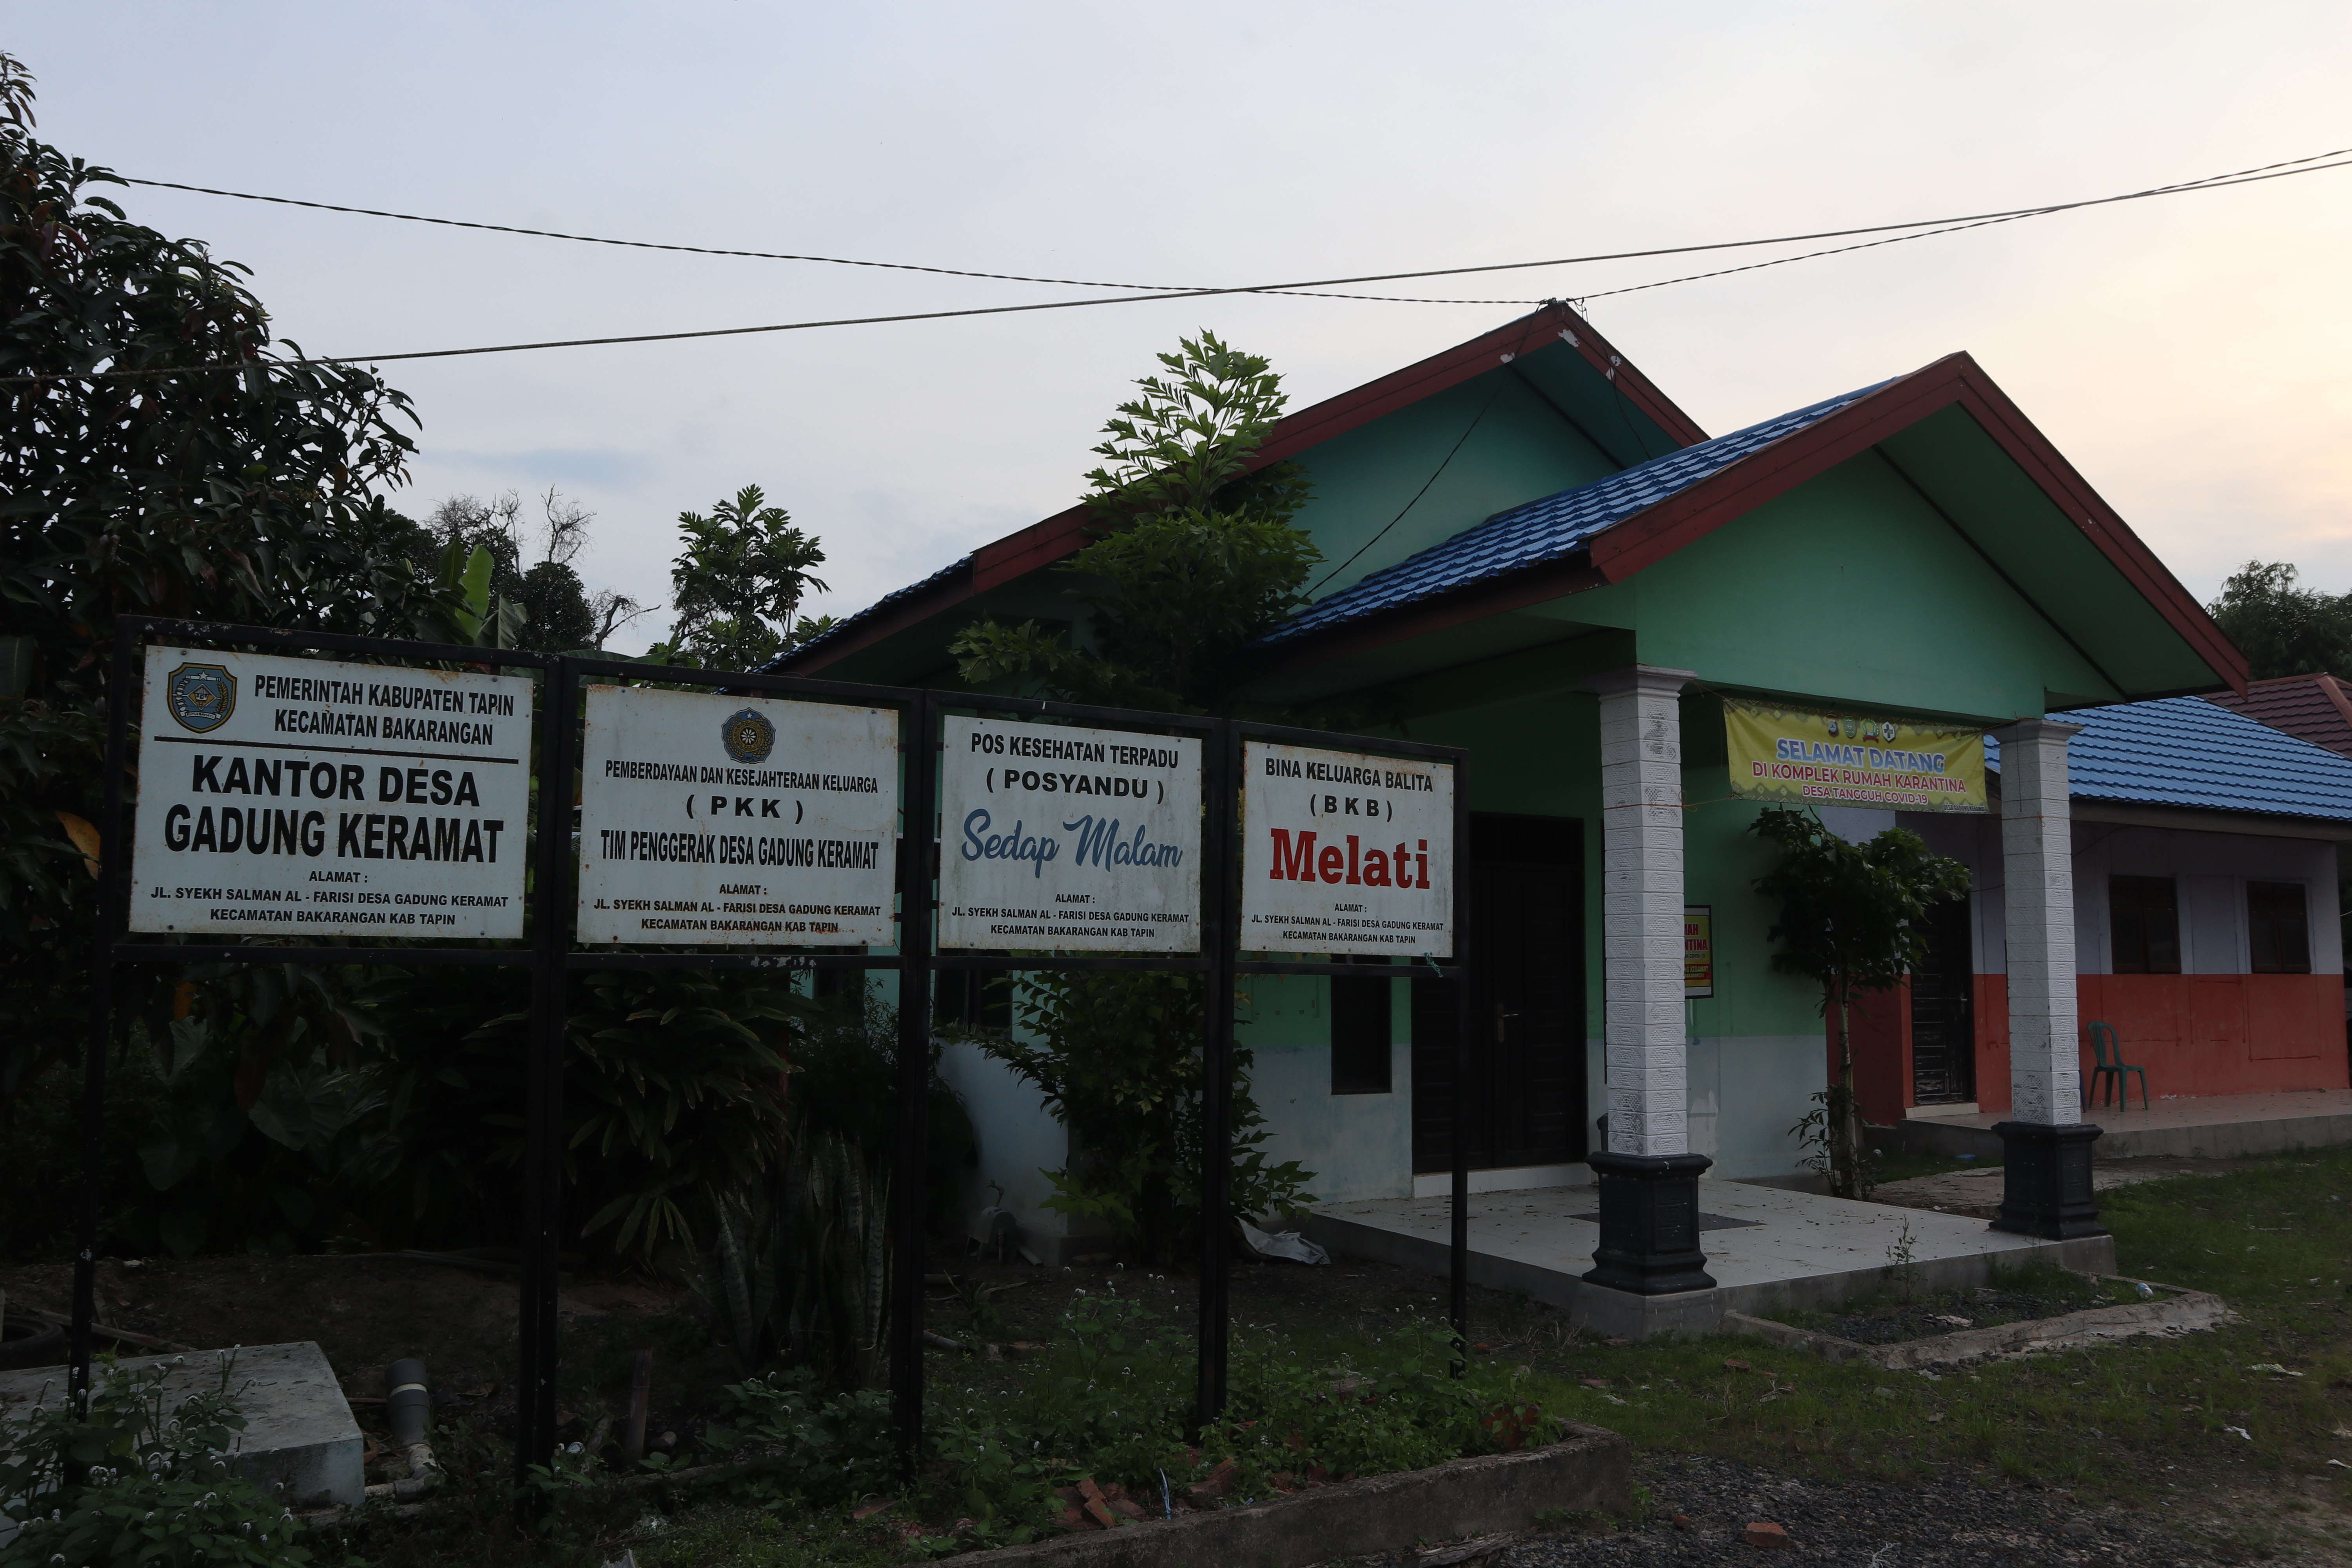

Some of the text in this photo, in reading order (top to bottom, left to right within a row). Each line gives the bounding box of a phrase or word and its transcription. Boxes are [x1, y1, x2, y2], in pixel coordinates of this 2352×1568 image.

[255, 675, 514, 716] PEMERINTAH KABUPATEN TAPIN
[274, 709, 493, 745] KECAMATAN BAKARANGAN
[971, 733, 1178, 769] POS KESEHATAN TERPADU
[1777, 738, 1945, 773] SELAMAT DATANG
[192, 755, 480, 807] KANTOR DESA
[606, 760, 878, 793] PEMBERDAYAAN DAN KESEJAHTERAAN KELUARGA
[1004, 769, 1148, 799] POSYANDU
[1266, 758, 1433, 792] BINA KELUARGA BALITA
[1752, 761, 1967, 793] DI KOMPLEK RUMAH KARANTINA
[1803, 785, 1928, 805] DESA TANGGUH COVID-19
[165, 804, 504, 863] GADUNG KERAMAT
[961, 808, 1183, 878] Sedap Malam
[601, 829, 879, 869] TIM PENGGERAK DESA GADUNG KERAMAT
[1270, 828, 1430, 889] Melati
[309, 871, 361, 883] ALAMAT
[719, 884, 761, 895] ALAMAT
[151, 887, 171, 898] JL.
[175, 887, 222, 900] SYEKH
[226, 889, 281, 901] SALMAN
[285, 890, 302, 902] AL
[314, 891, 354, 903] FARISI
[358, 893, 390, 904] DESA
[394, 894, 447, 906] GADUNG
[451, 895, 508, 907] KERAMAT
[593, 898, 610, 909] JL.
[613, 899, 650, 911] SYEKH
[654, 900, 698, 912] SALMAN
[701, 902, 714, 912] AL
[723, 902, 756, 913] FARISI
[759, 903, 786, 914] DESA
[789, 904, 831, 915] GADUNG
[834, 905, 881, 916] KERAMAT
[1055, 894, 1090, 904] ALAMAT
[1334, 903, 1363, 913] ALAMAT
[211, 909, 455, 925] KECAMATAN BAKARANGAN KAB TAPIN
[641, 918, 839, 934] KECAMATAN BAKARANGAN KAB TAPIN
[952, 907, 965, 916] JL.
[968, 907, 998, 917] SYEKH
[1001, 908, 1037, 918] SALMAN
[1039, 910, 1051, 919] AL
[1058, 910, 1086, 920] FARISI
[1089, 911, 1111, 921] DESA
[1113, 912, 1149, 922] GADUNG
[1151, 913, 1189, 923] KERAMAT
[1251, 914, 1263, 923] JL.
[1265, 915, 1289, 924] SYEKH
[1291, 916, 1320, 926] SALMAN
[1322, 918, 1331, 926] AL
[1338, 918, 1359, 927] FARISI
[1362, 920, 1380, 928] DESA
[1382, 920, 1410, 929] GADUNG
[1413, 922, 1444, 931] KERAMAT
[991, 924, 1154, 937] KECAMATAN BAKARANGAN KAB TAPIN
[1283, 930, 1416, 944] KECAMATAN BAKARANGAN KAB TAPIN
